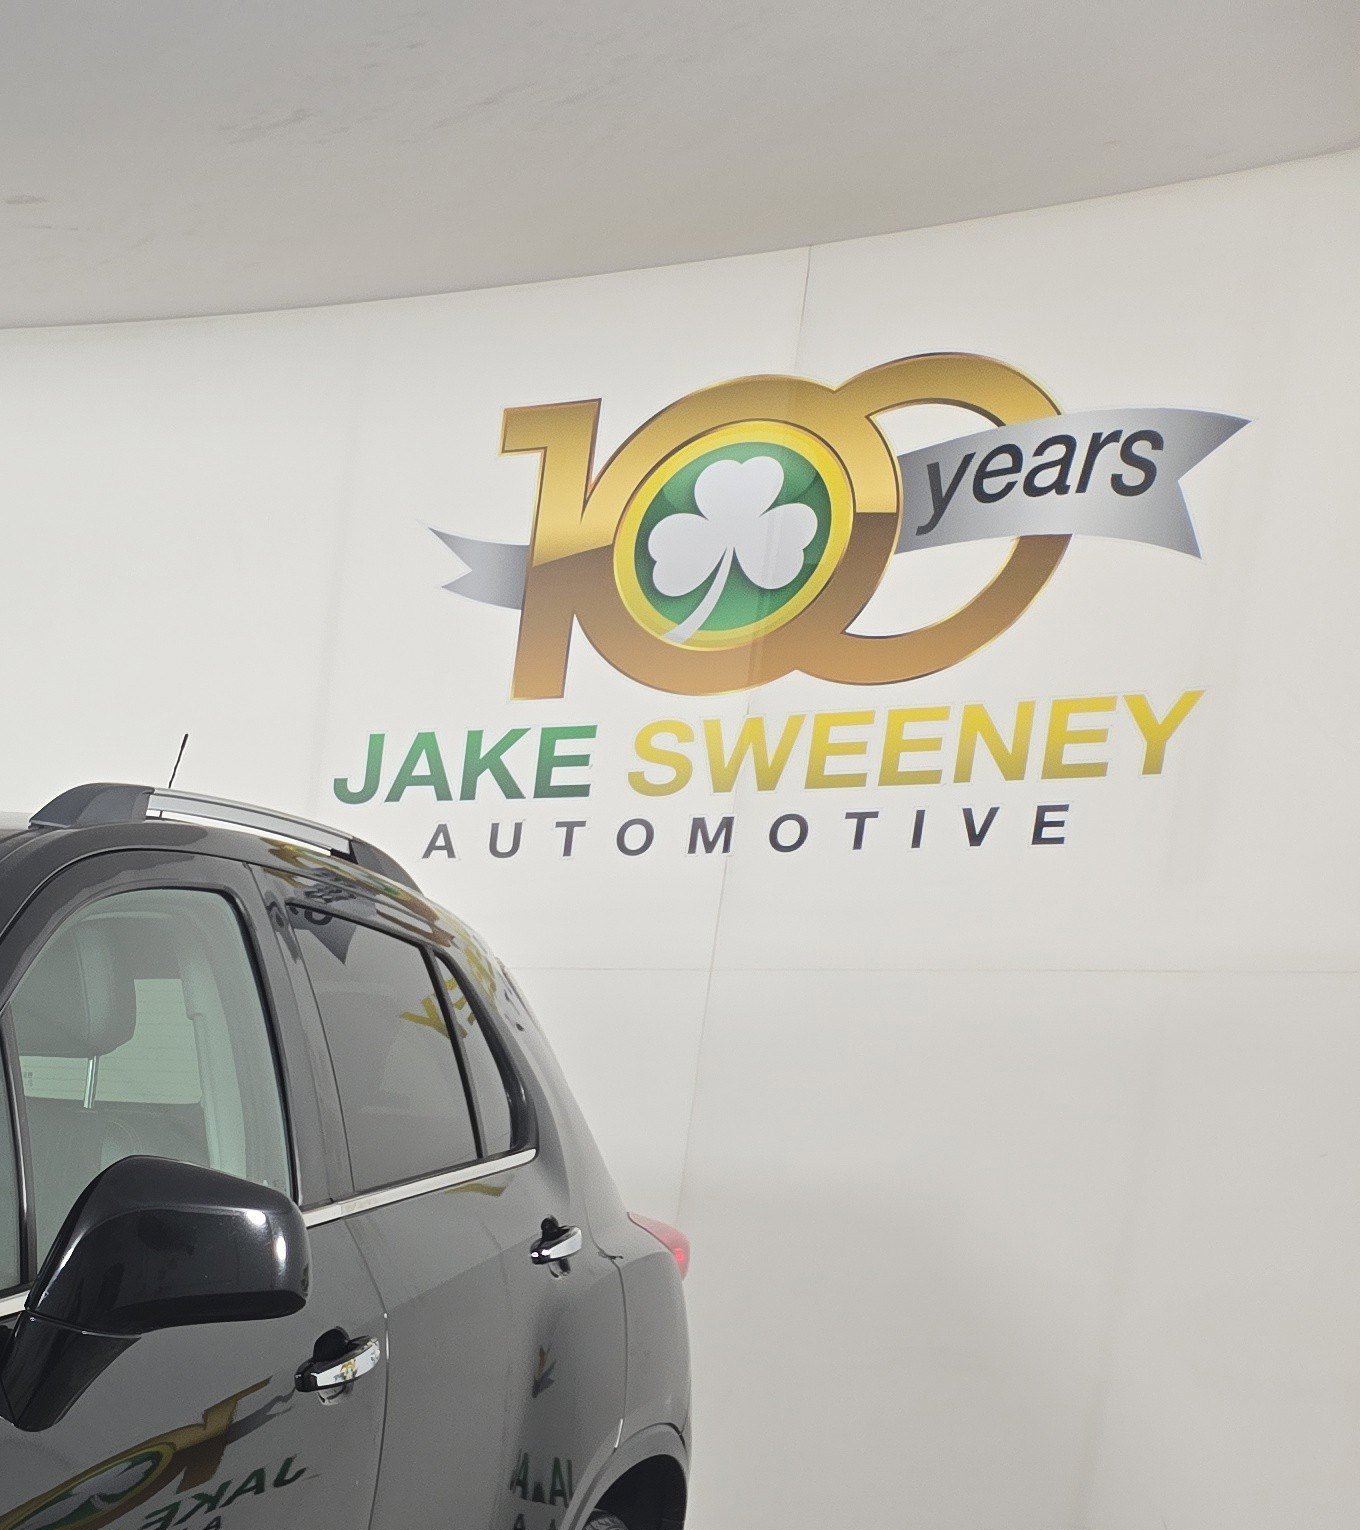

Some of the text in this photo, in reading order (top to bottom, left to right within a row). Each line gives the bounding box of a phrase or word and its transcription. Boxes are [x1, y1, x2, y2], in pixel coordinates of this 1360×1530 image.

[915, 427, 1165, 537] years
[333, 689, 1206, 805] JAKE SWEENEY
[422, 803, 1071, 860] AUTOMOTIVE
